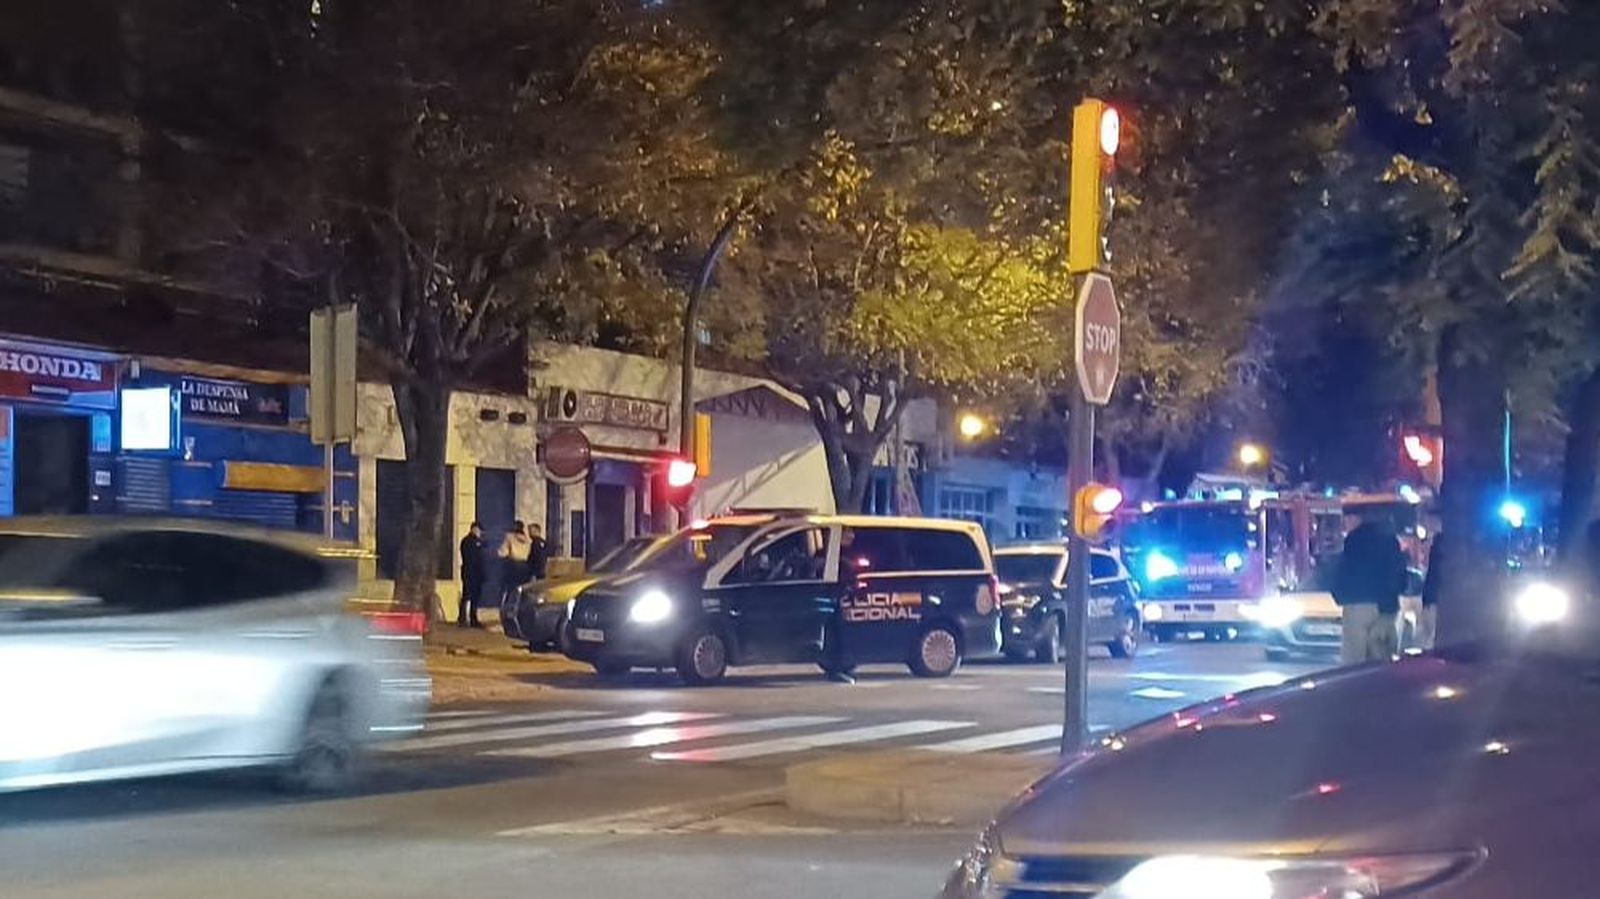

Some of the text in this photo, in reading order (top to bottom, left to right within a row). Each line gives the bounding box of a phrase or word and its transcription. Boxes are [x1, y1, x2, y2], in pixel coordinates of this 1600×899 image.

[1086, 322, 1116, 354] STOP
[0, 352, 101, 381] HONDA
[181, 379, 249, 400] LA DESPENSA
[189, 398, 206, 411] DE
[840, 592, 902, 607] LICIA
[843, 605, 922, 622] CIONAL
